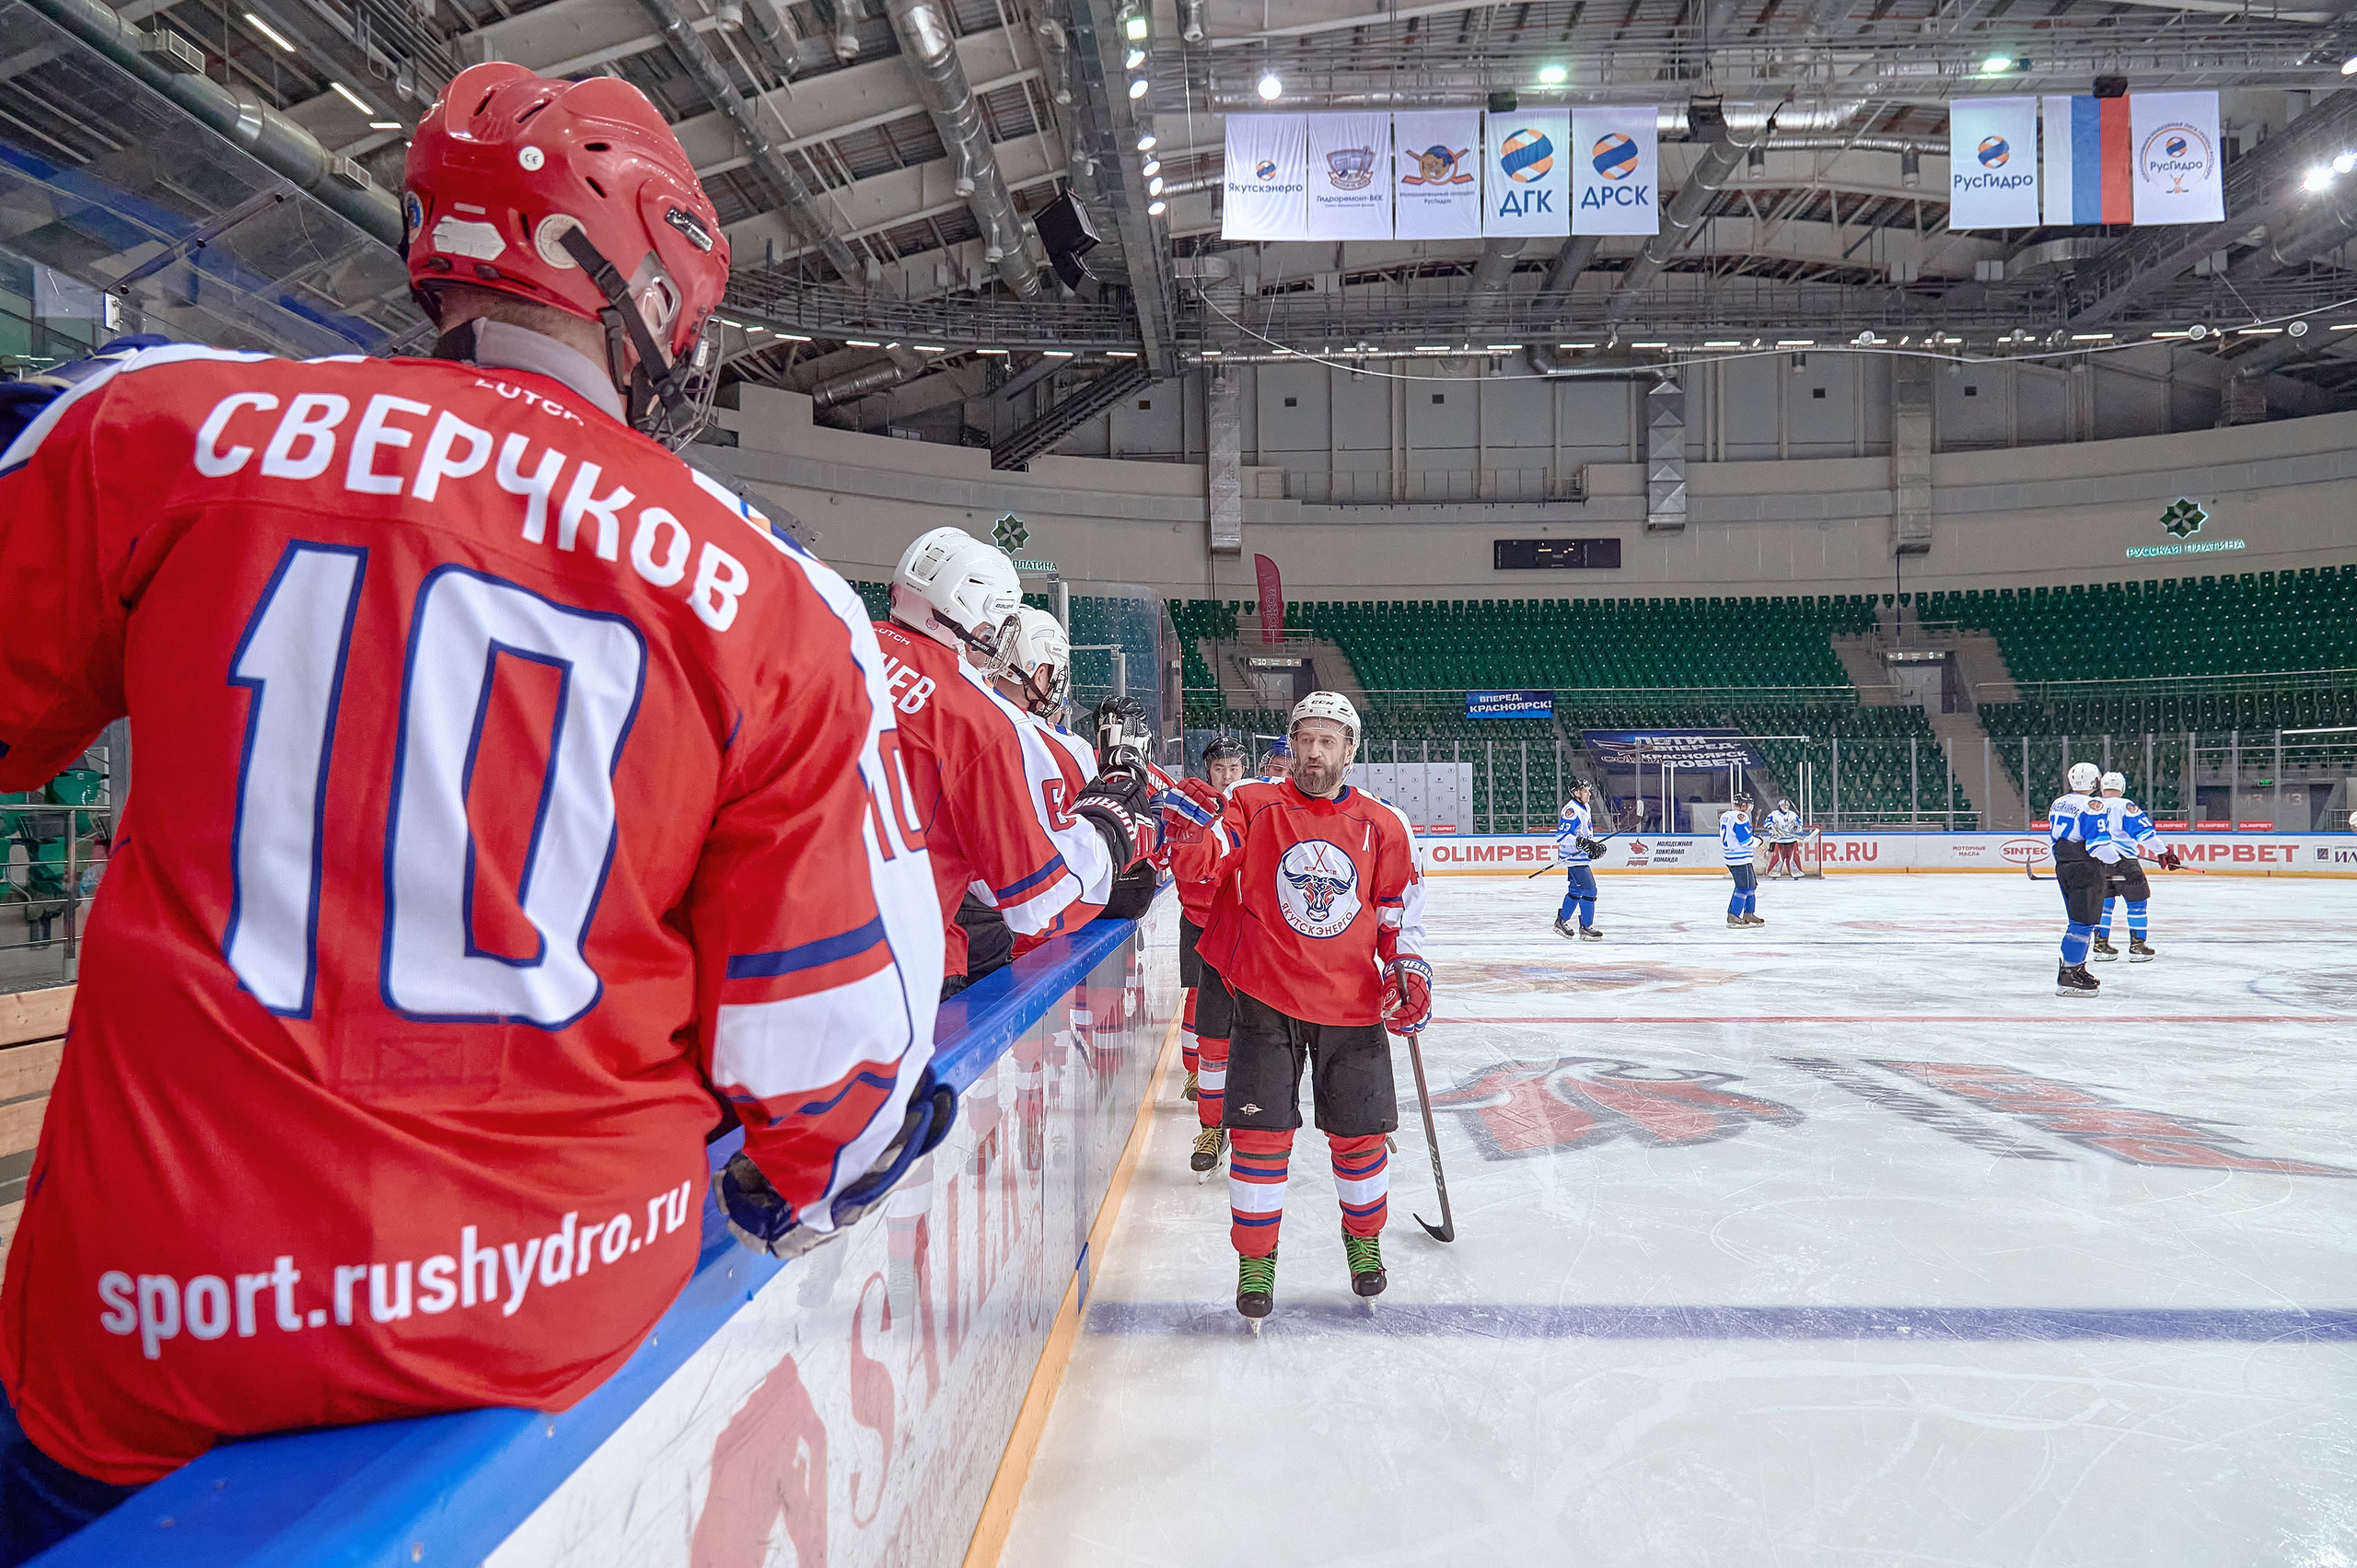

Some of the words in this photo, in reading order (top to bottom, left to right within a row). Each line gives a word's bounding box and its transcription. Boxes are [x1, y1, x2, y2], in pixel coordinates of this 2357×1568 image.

[2150, 160, 2203, 173] РусГидро
[1228, 182, 1303, 194] Якутскэнерго
[1954, 173, 2034, 192] РусГидро
[1499, 190, 1553, 217] ДГК
[1581, 185, 1649, 210] ДРСК
[194, 391, 749, 632] СВЕРЧКОВ
[2127, 545, 2182, 558] РУССКАЯ
[2184, 540, 2246, 553] ПЛАТИНА
[1012, 560, 1058, 571] ПЛАТИНА
[1479, 693, 1523, 703] ВПЕРЕД,
[1469, 700, 1552, 713] КРАСНОЯРСК!
[1642, 750, 1749, 761] КРАСНОЯРСК
[1663, 757, 1752, 768] ЗОВЕТ!
[222, 539, 648, 1031] 10
[2003, 847, 2048, 855] SINTEC
[1282, 902, 1353, 935] ЯКУТСКЭНЕРГО
[98, 1179, 691, 1360] sport.rushydro.ru
